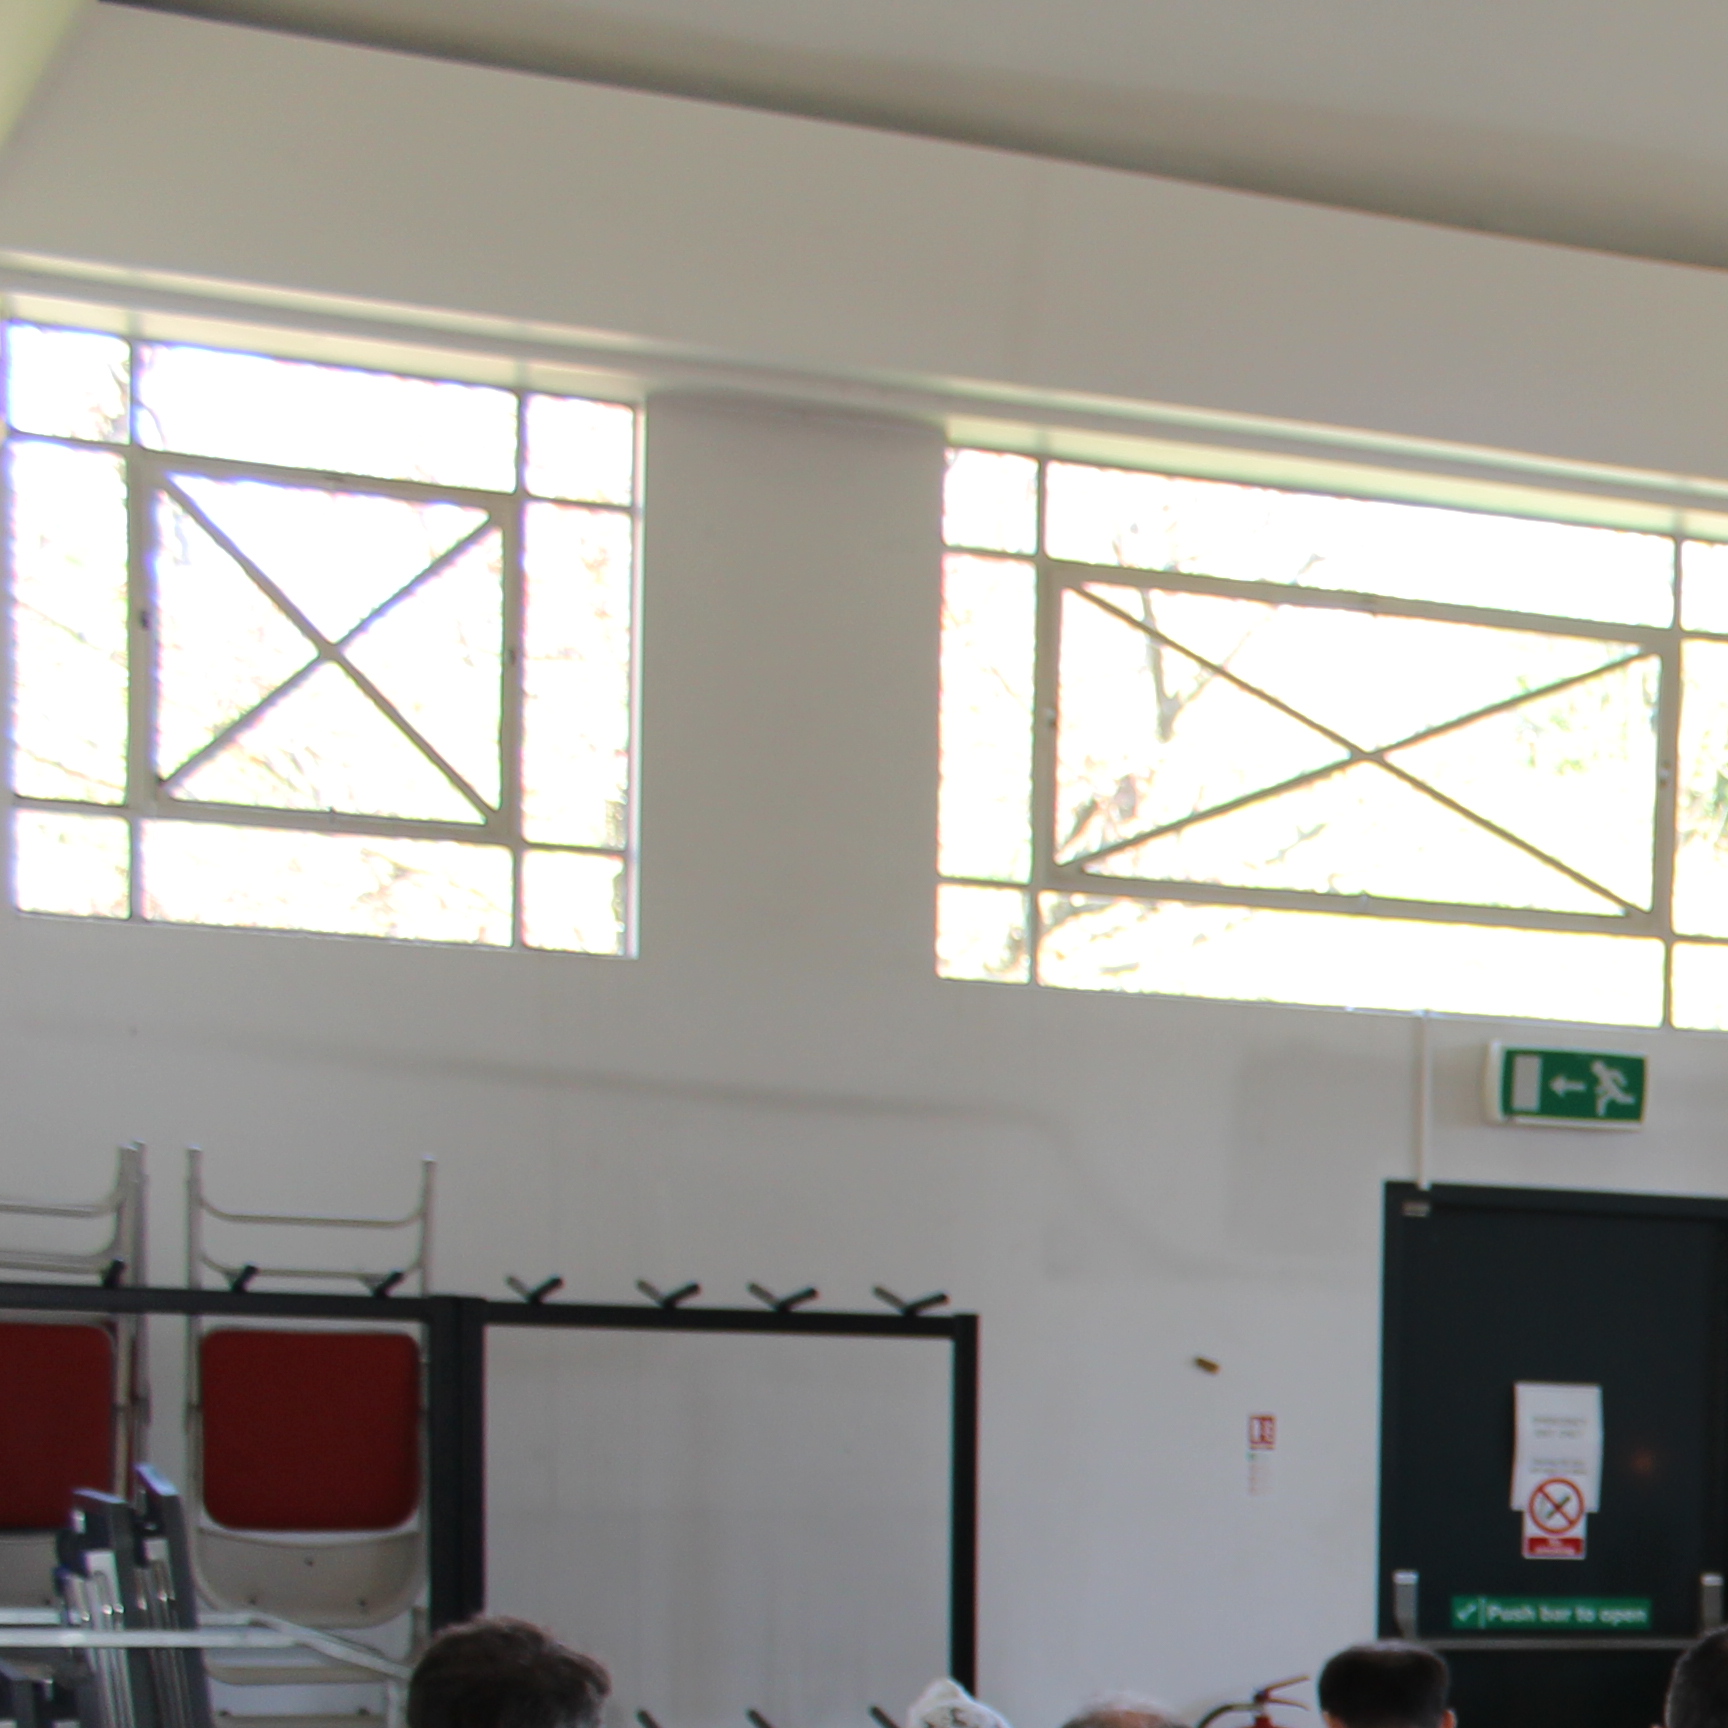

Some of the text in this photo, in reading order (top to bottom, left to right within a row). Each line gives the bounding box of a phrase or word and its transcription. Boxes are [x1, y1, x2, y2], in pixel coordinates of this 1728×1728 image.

[1486, 1604, 1648, 1627] Push bar to open
